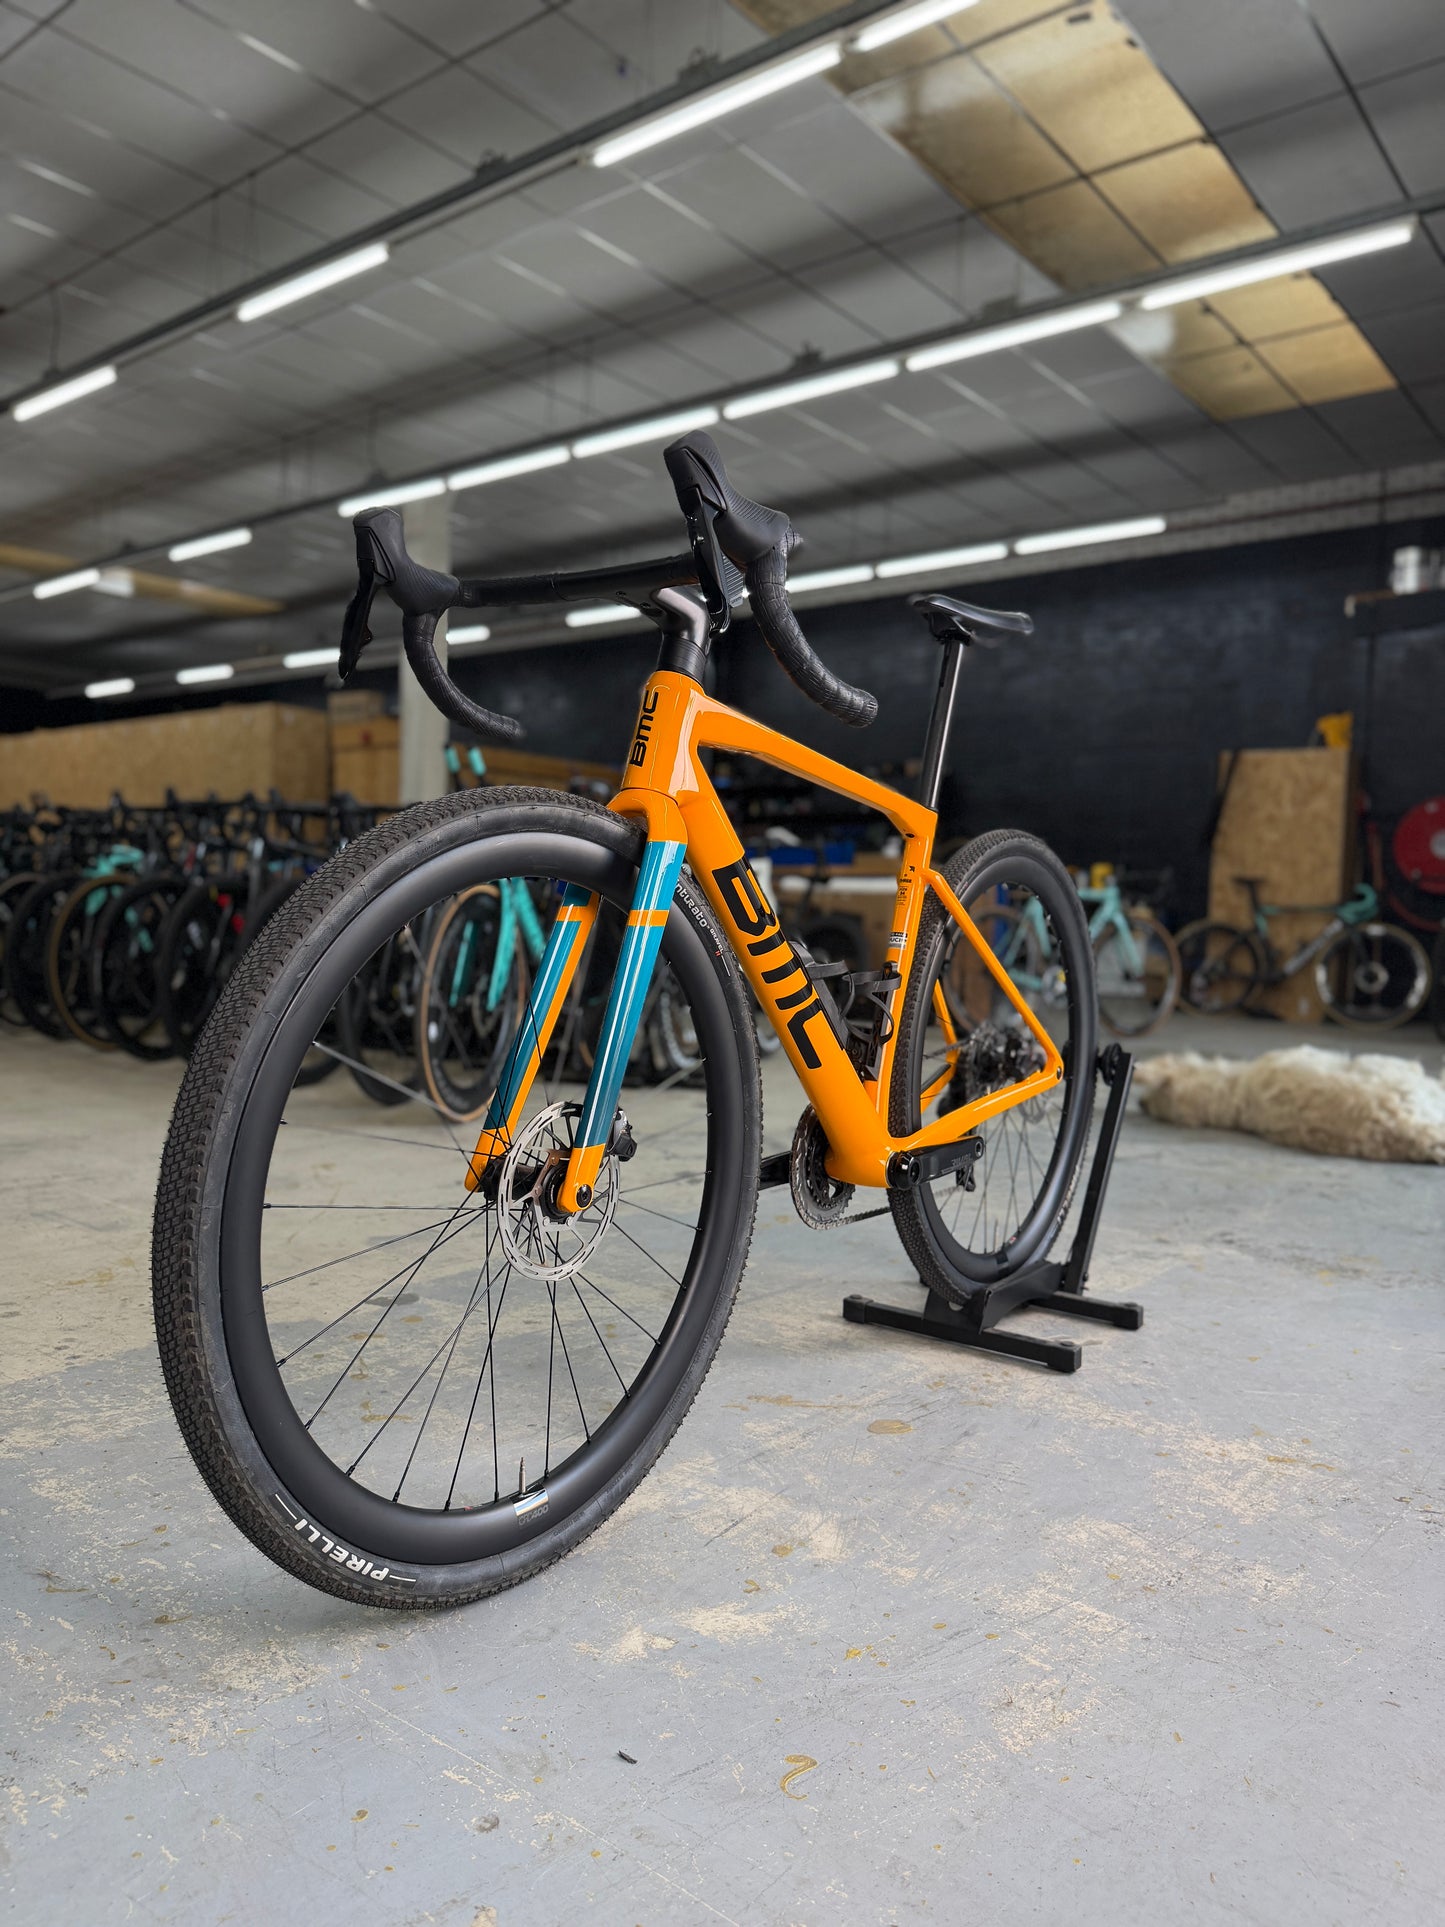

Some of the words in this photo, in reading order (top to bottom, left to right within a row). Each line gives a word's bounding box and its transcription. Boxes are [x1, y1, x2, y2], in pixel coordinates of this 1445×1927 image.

[629, 689, 659, 767] BMC
[712, 858, 845, 1070] BMC
[294, 1518, 391, 1582] PIRELLI
